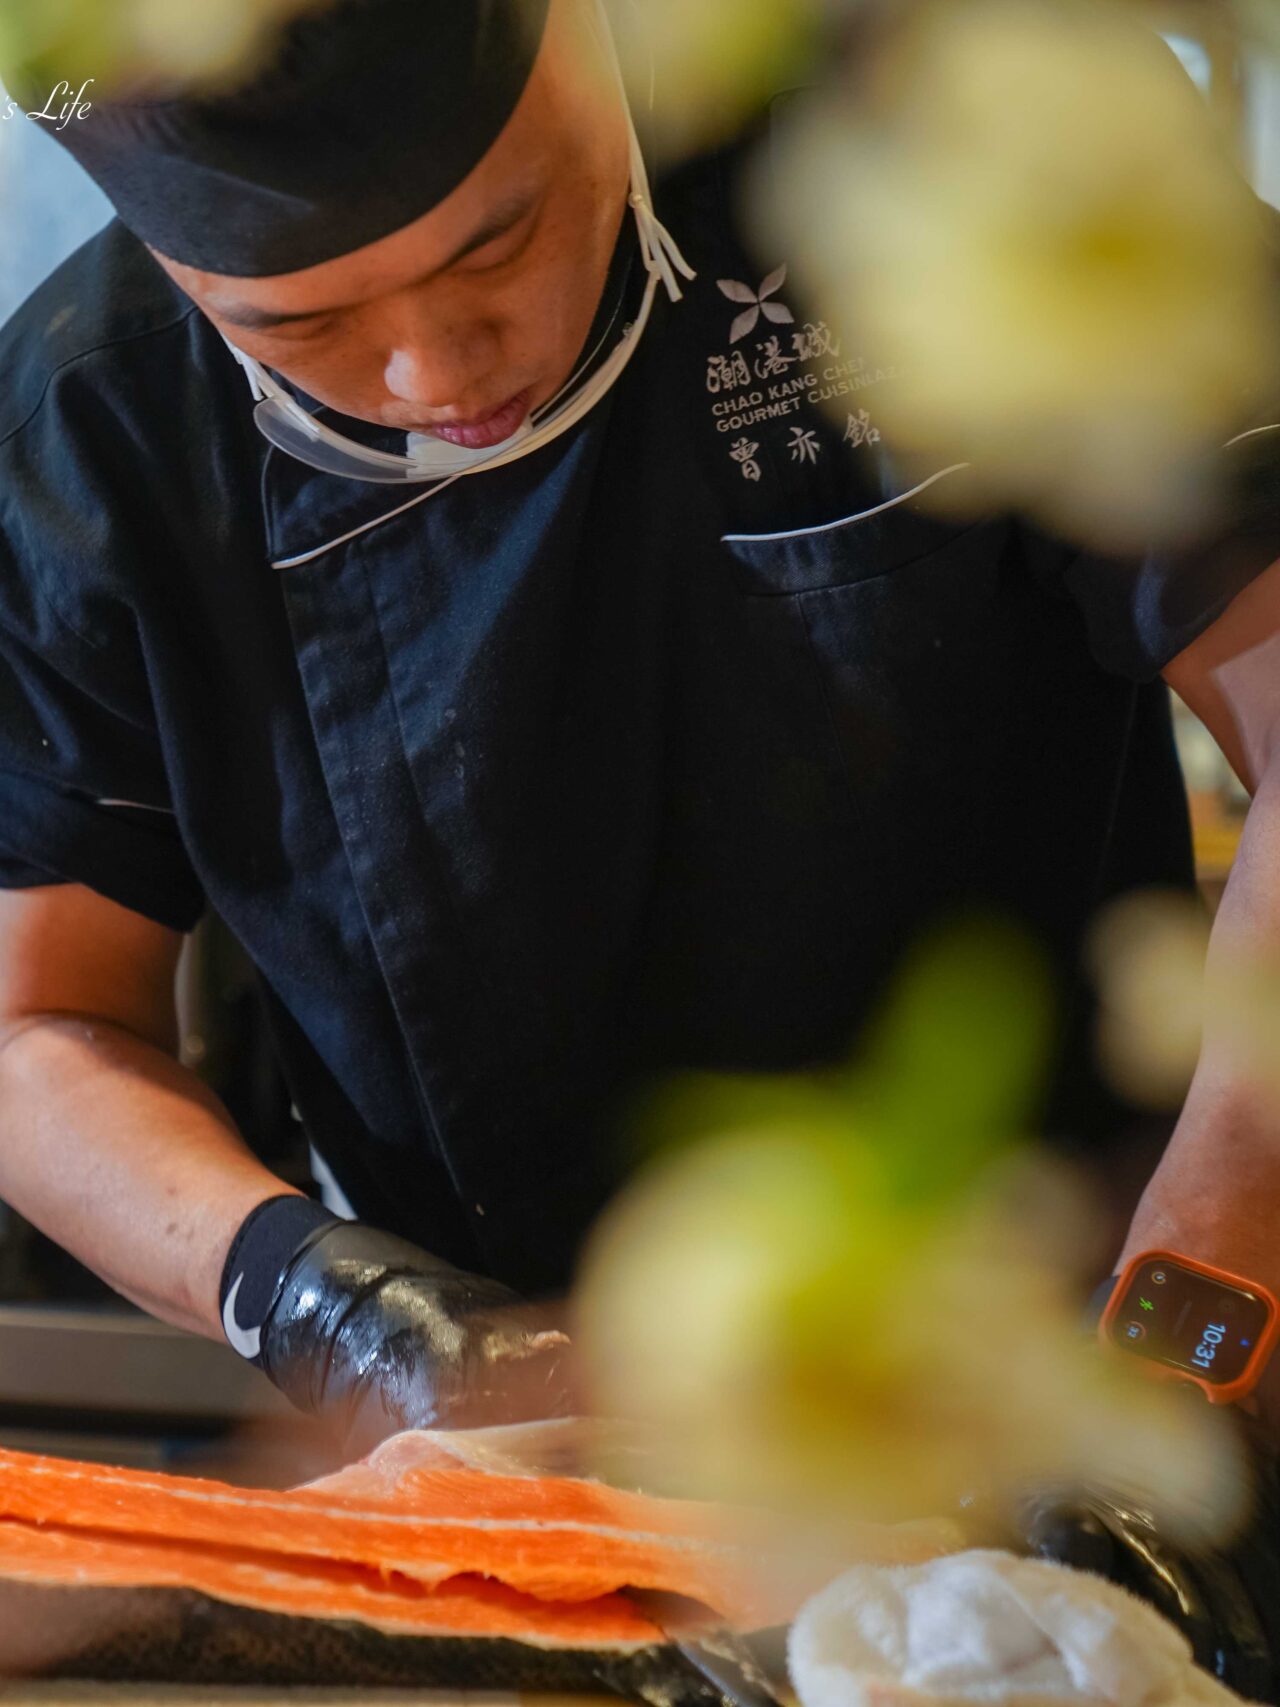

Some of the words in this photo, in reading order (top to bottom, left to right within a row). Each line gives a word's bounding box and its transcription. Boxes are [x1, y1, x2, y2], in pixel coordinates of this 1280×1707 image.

[711, 391, 763, 417] CHAO
[769, 373, 818, 400] KANG
[716, 396, 801, 433] GOURMET
[1191, 1323, 1227, 1368] 10:31
